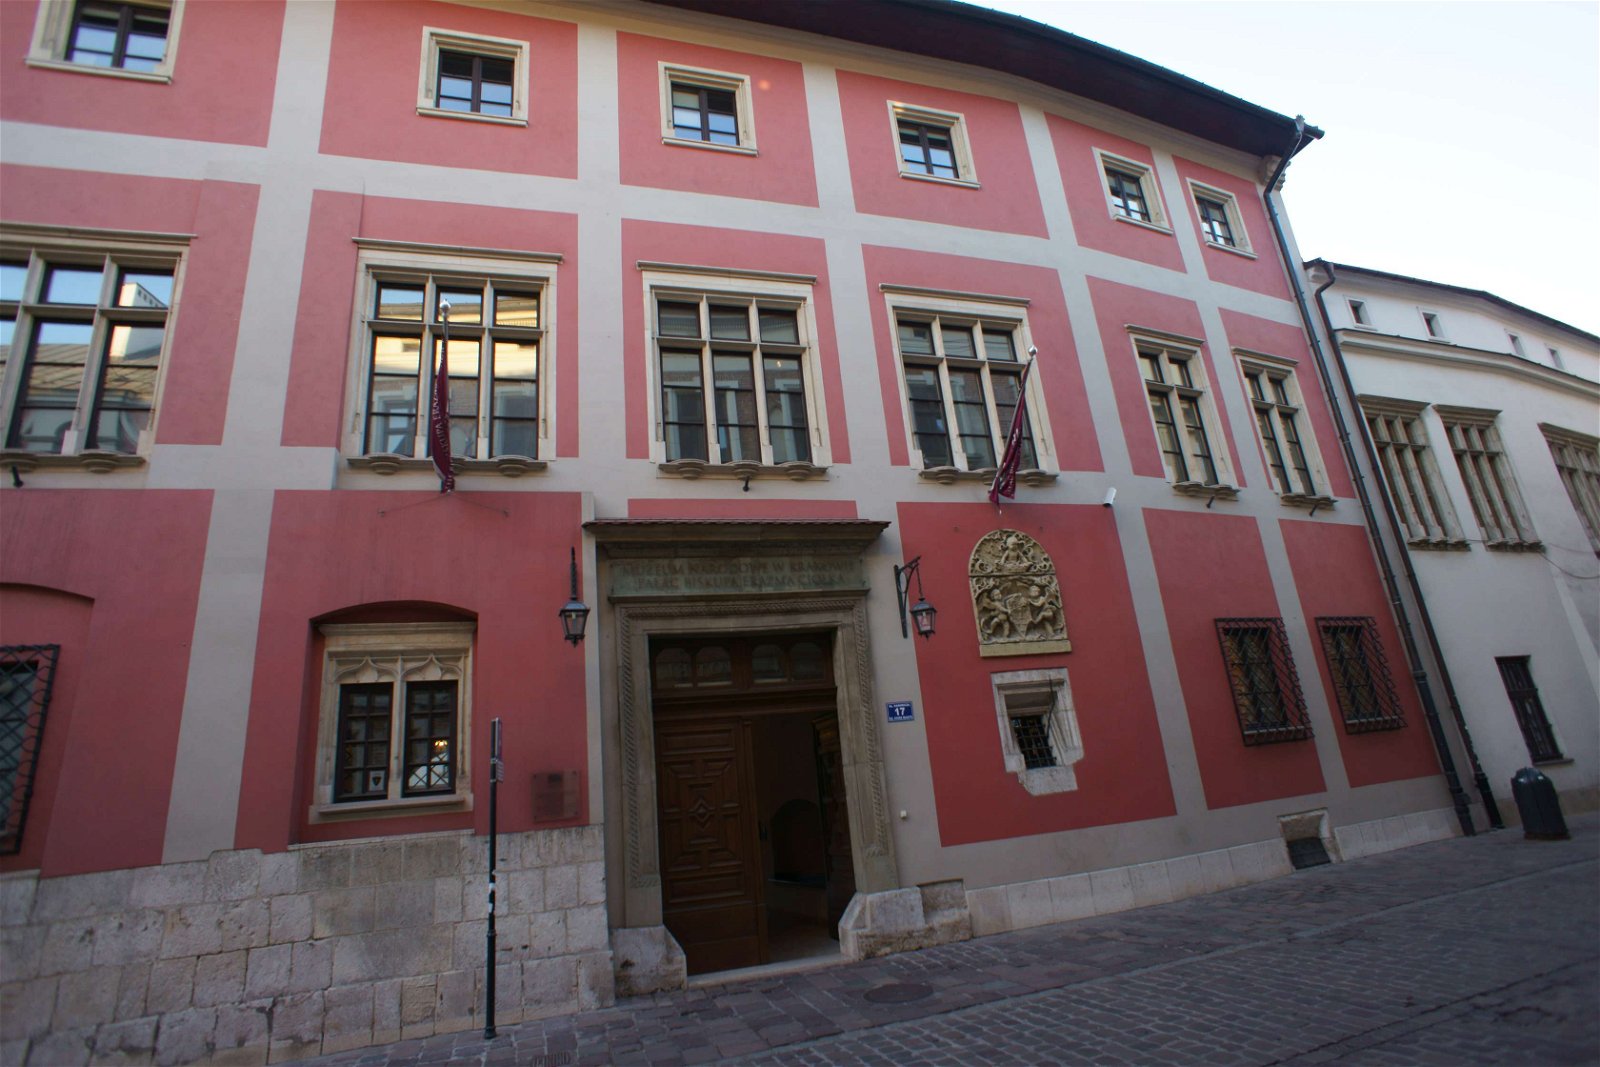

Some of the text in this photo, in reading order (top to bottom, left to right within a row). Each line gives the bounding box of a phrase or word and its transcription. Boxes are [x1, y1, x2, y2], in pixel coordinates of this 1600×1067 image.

[621, 562, 685, 577] MUZEUM
[773, 560, 786, 572] W
[684, 575, 740, 589] BISKUPA
[895, 707, 905, 716] 17
